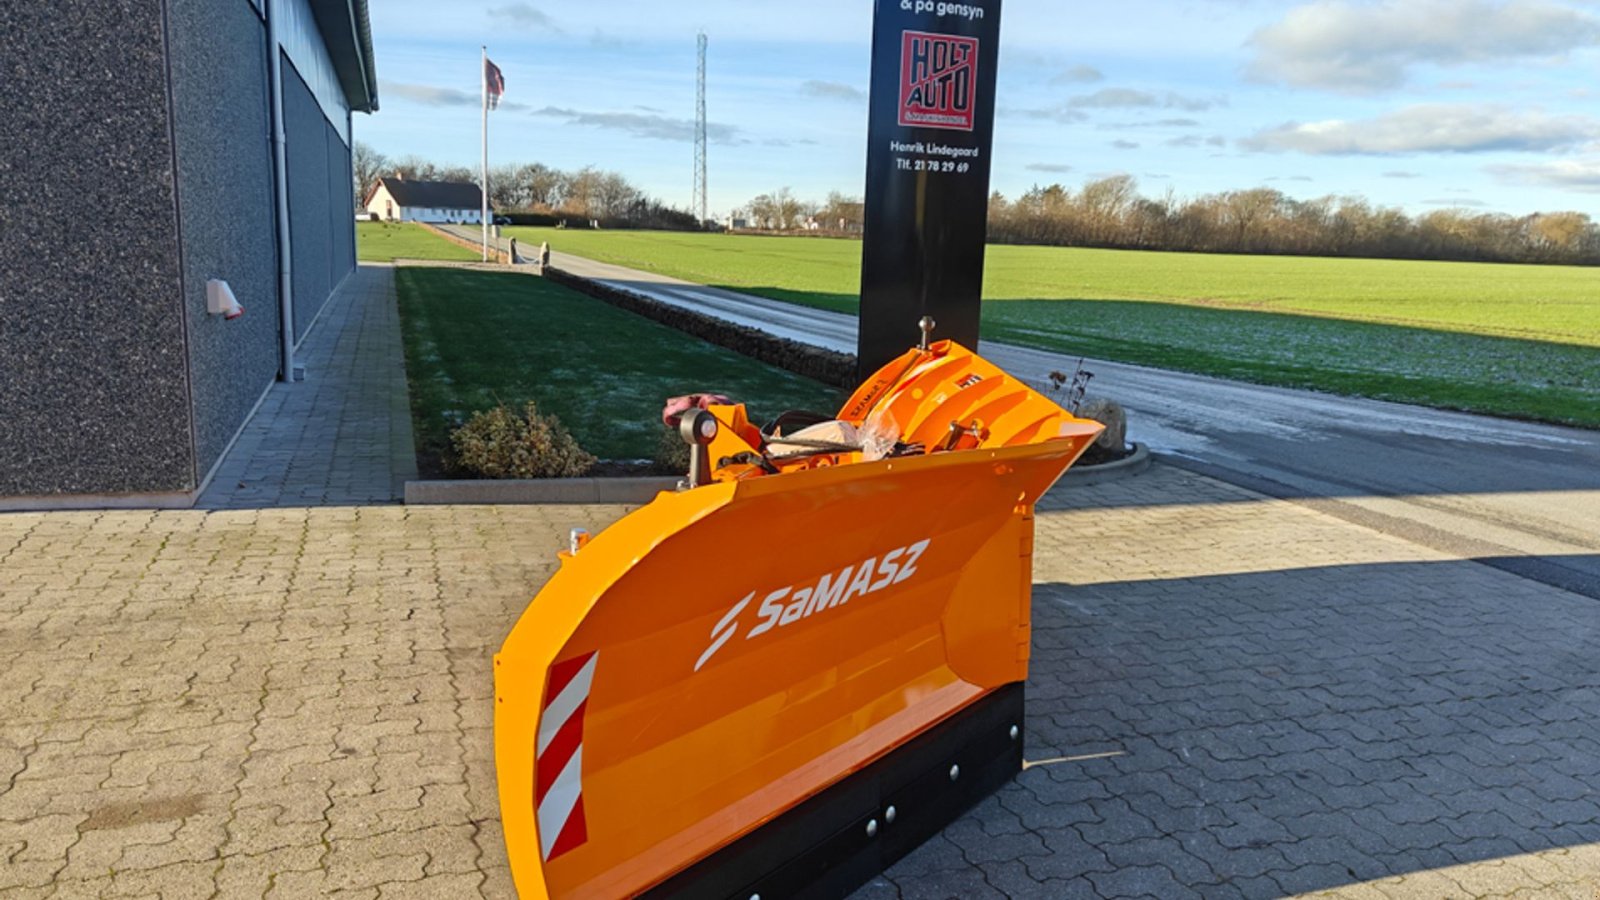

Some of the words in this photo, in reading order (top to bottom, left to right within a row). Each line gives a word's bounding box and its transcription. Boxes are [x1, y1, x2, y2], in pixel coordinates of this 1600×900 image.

[900, 0, 912, 9] &
[936, 2, 984, 20] gensyn
[910, 37, 972, 86] HOLT
[905, 64, 971, 112] AUTO
[890, 141, 925, 153] Henrik
[926, 143, 979, 158] Lindegaard
[896, 158, 912, 170] Tlf.
[914, 160, 926, 171] 21
[927, 161, 940, 171] 78
[941, 161, 956, 173] 29
[956, 162, 970, 173] 69
[745, 538, 931, 640] SaMASZ
